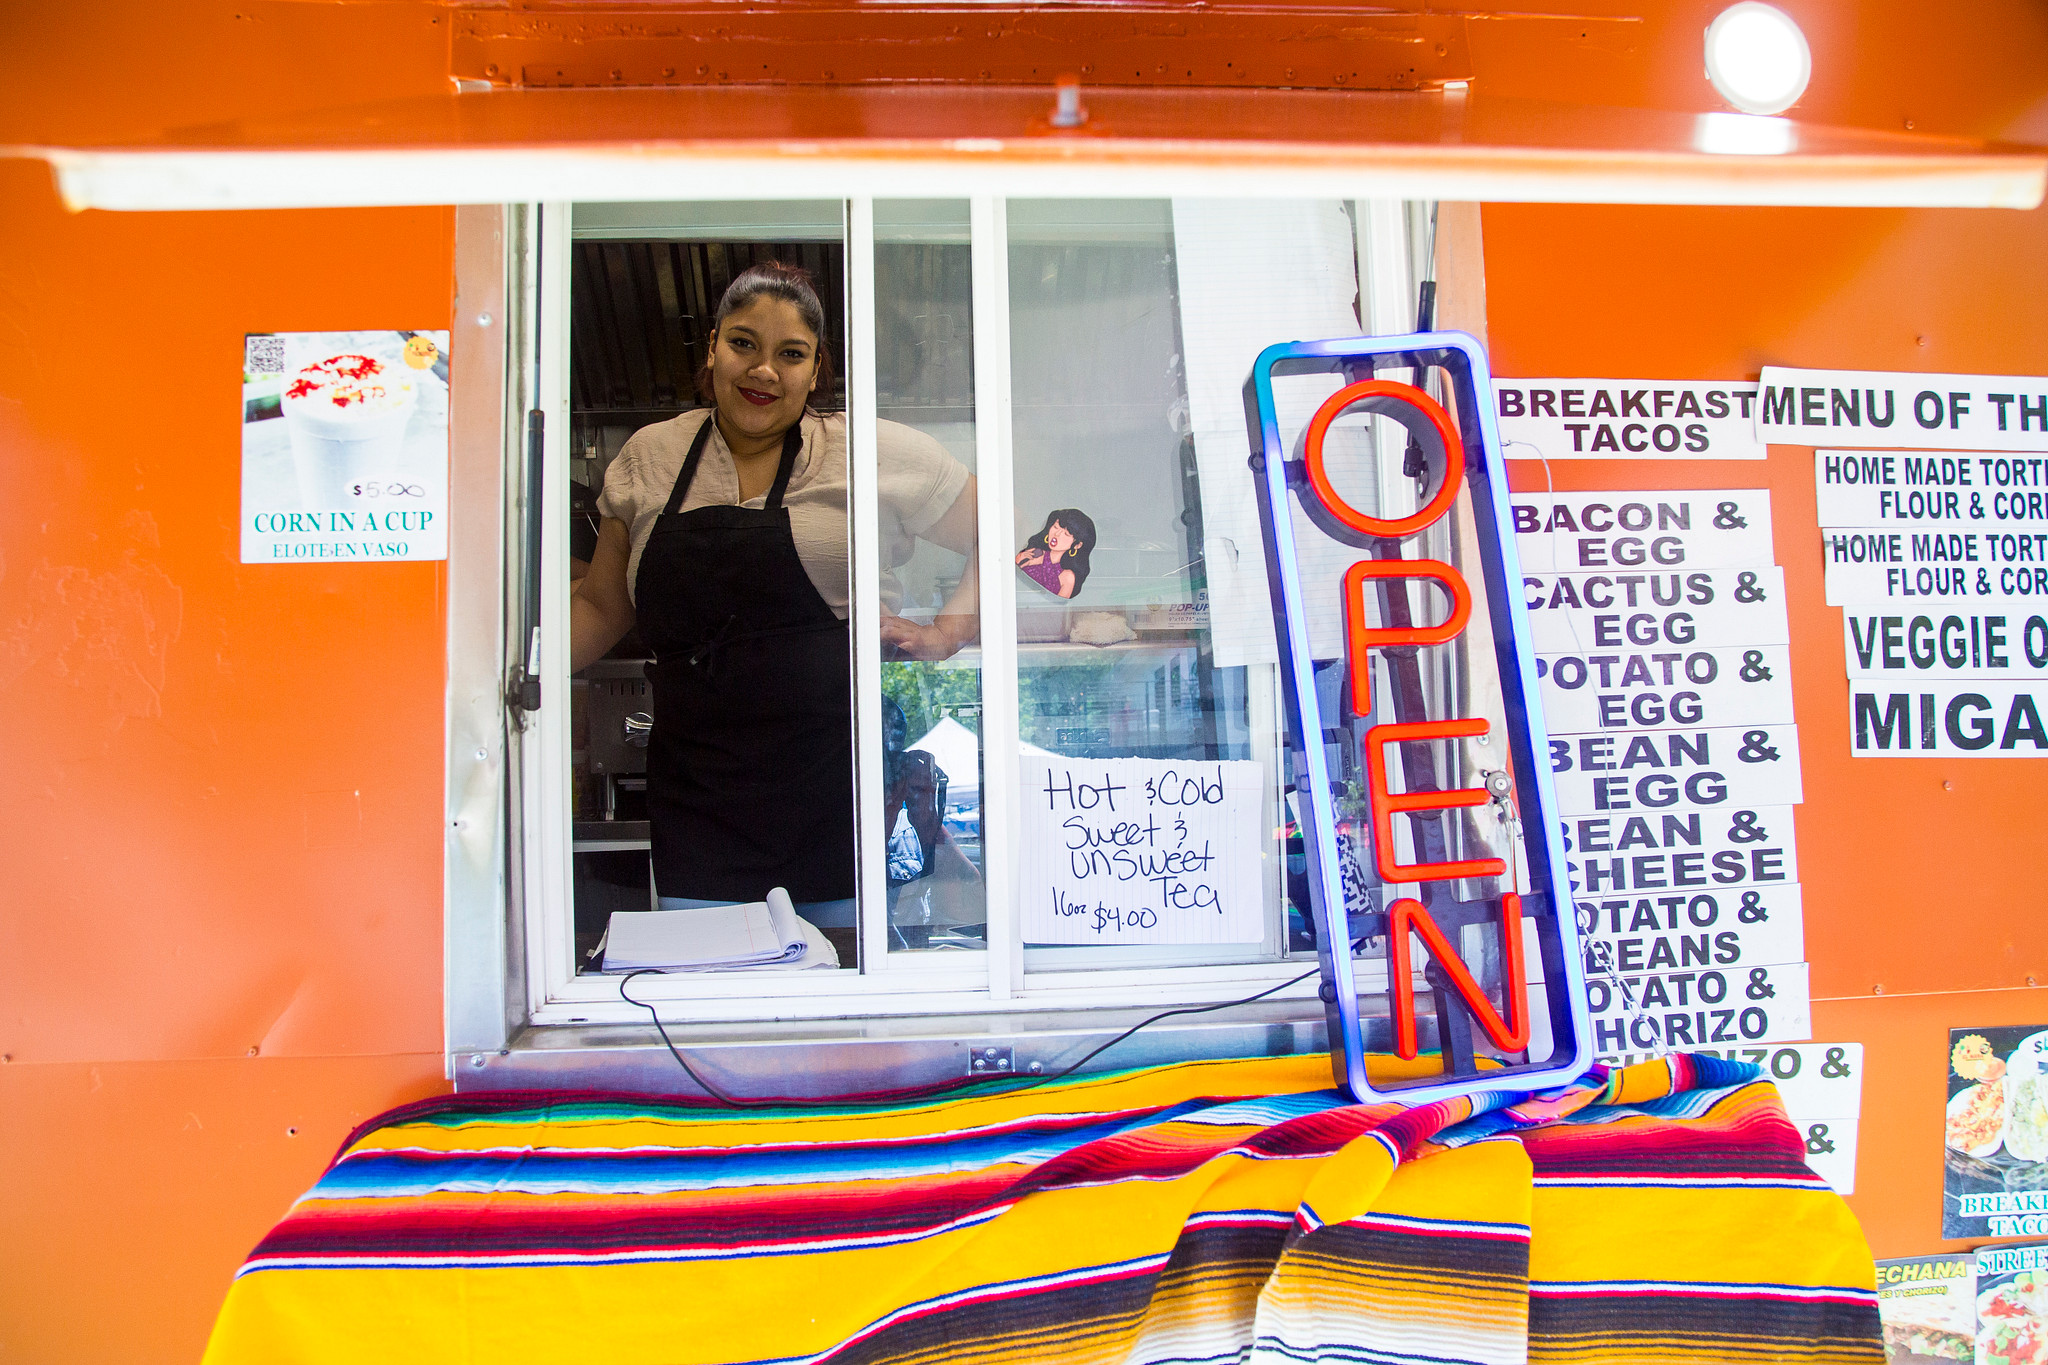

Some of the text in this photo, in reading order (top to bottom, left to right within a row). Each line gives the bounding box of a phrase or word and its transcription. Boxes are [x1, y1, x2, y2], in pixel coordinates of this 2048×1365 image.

[1498, 388, 1756, 419] BREAKFAST
[1762, 385, 2048, 432] MENU OF TH
[1564, 423, 1710, 453] TACOS
[1825, 456, 1896, 485] HOME
[1905, 457, 1971, 486] MADE
[254, 511, 433, 533] CORN IN A CUP
[1511, 501, 1748, 533] BACON &
[1879, 490, 1960, 519] FLOUR
[1969, 491, 1986, 520] &
[273, 542, 408, 558] ELOTE EN VASO
[1577, 536, 1685, 566] EGG
[1831, 533, 2048, 563] HOME MADE TORT
[1523, 571, 1767, 610] CACTUS &
[1887, 567, 1967, 597] FLOUR
[1976, 567, 1992, 596] &
[1169, 603, 1209, 612] POP-UP
[1594, 612, 1696, 647] EGG
[1848, 615, 2008, 669] VEGGIE
[1739, 649, 1773, 682] &
[1304, 378, 1532, 1061] OPEN
[1598, 691, 1704, 727] EGG
[1855, 692, 2048, 751] MIGA
[1737, 729, 1781, 764] &
[1043, 768, 1126, 811] Hot
[1158, 765, 1223, 806] Cold
[1593, 771, 1727, 810] EGG
[1063, 813, 1161, 849] Sweet
[1727, 810, 1769, 844] &
[1150, 876, 1222, 914] Tea
[1091, 901, 1157, 933] $4.00
[1576, 890, 1769, 935] OTATO &
[1585, 931, 1741, 974] BEANS
[1587, 967, 1776, 1013] OTATO &
[1596, 1007, 1768, 1052] HORIZO
[1820, 1047, 1851, 1078] &
[1805, 1123, 1836, 1155] &
[1875, 1260, 1967, 1284] ECHANA
